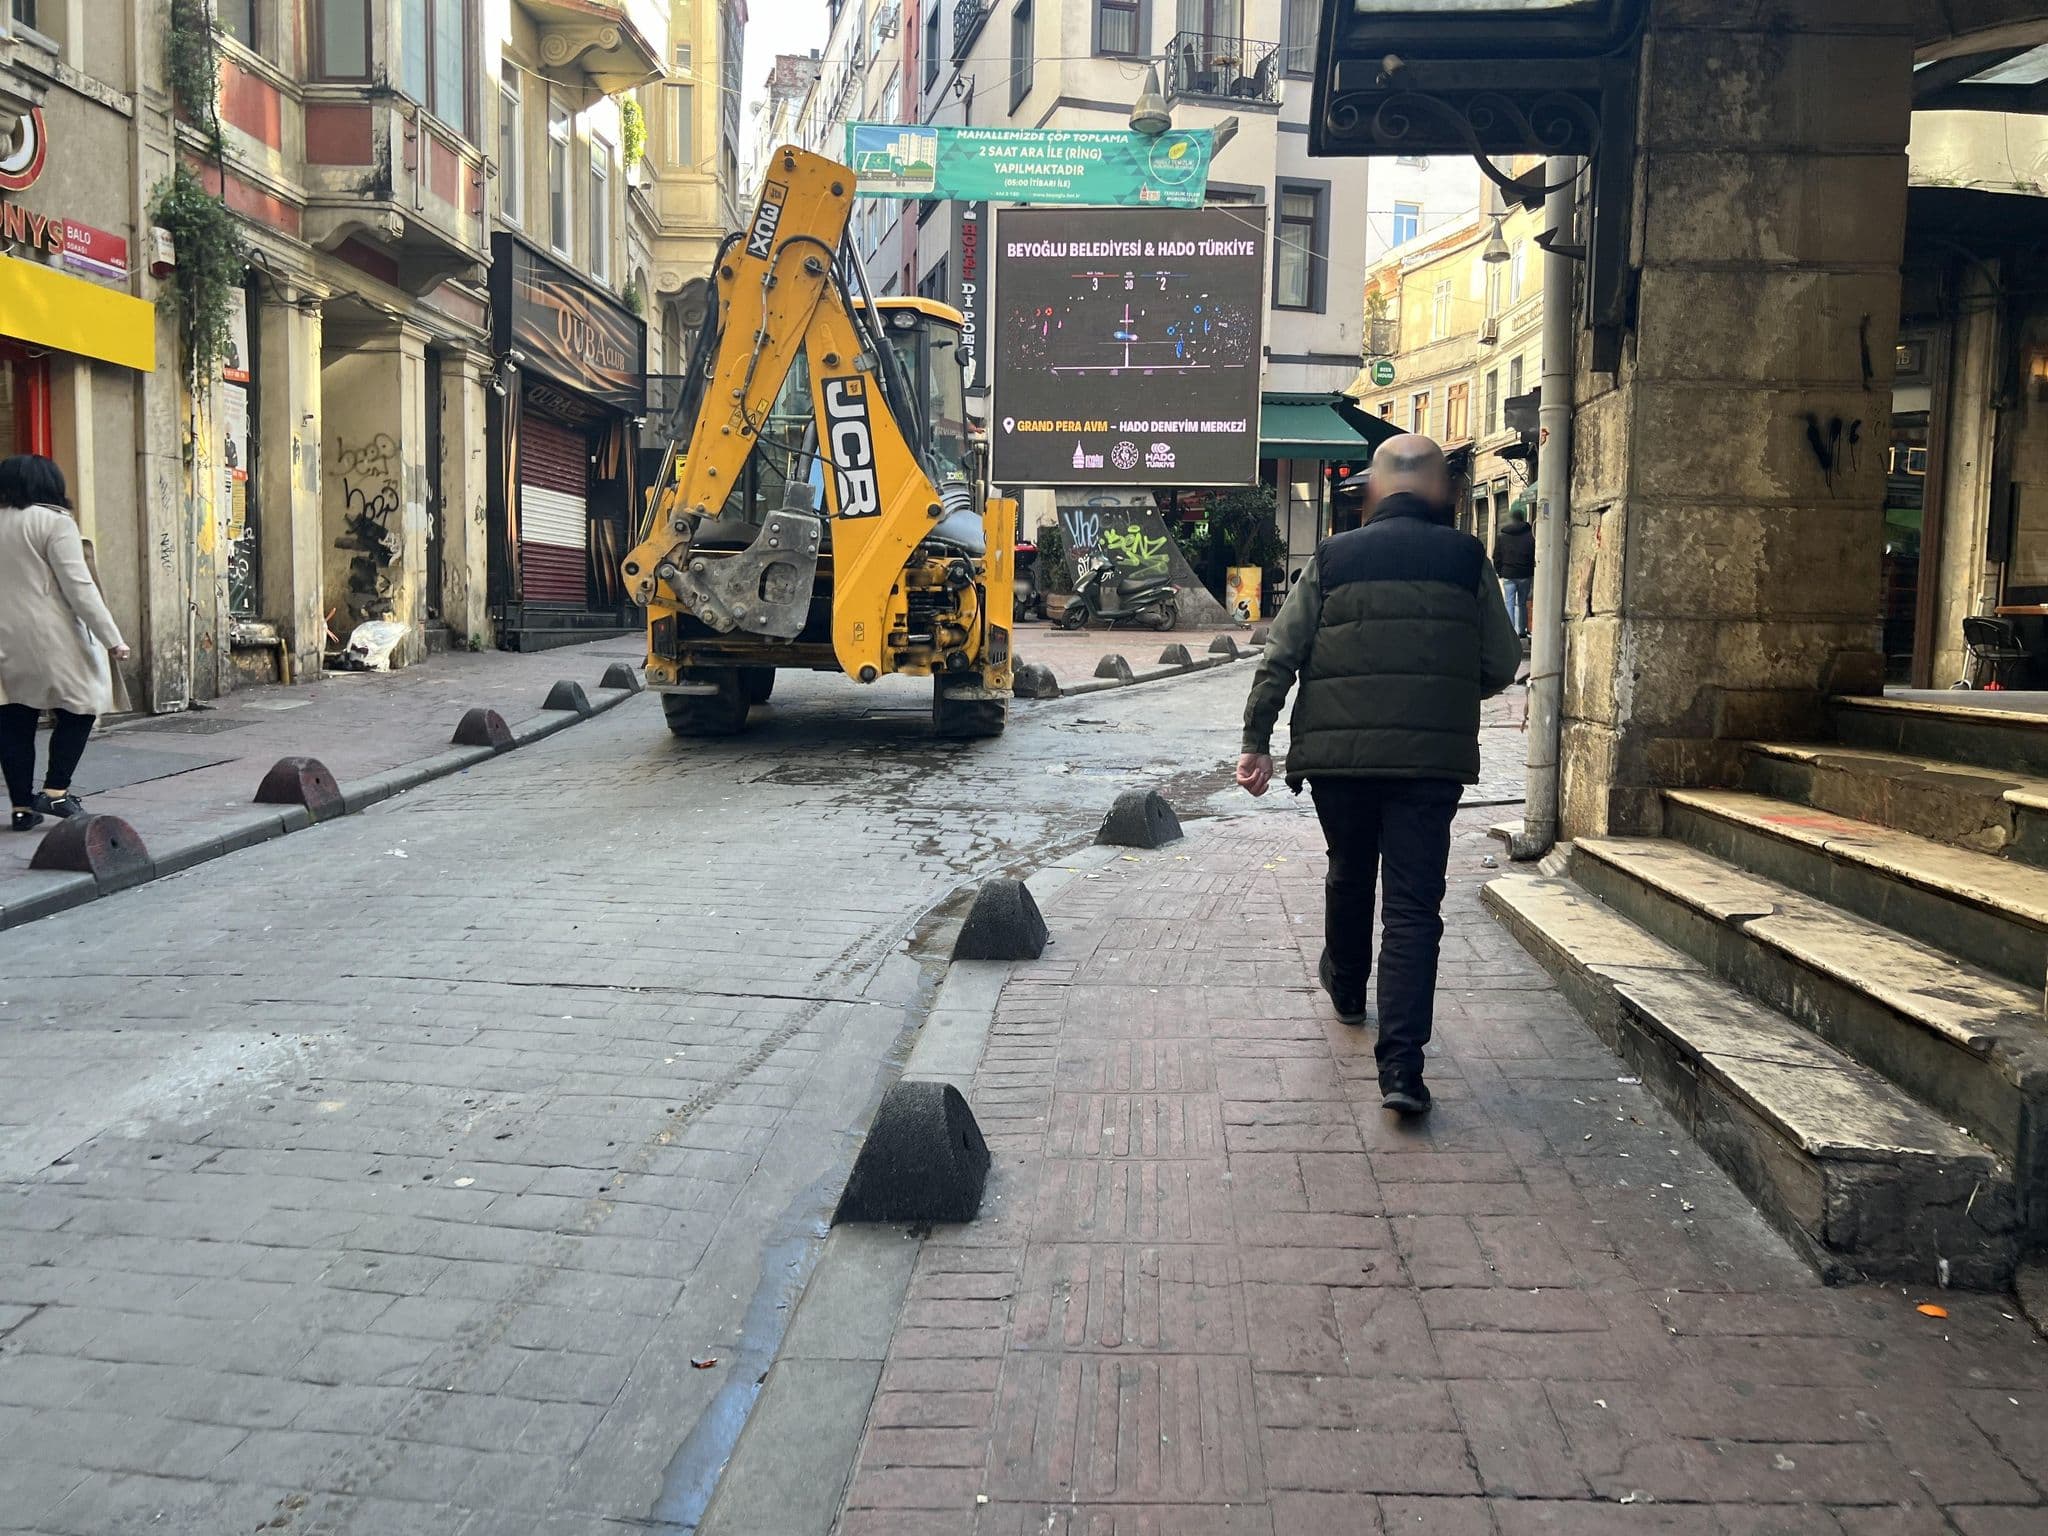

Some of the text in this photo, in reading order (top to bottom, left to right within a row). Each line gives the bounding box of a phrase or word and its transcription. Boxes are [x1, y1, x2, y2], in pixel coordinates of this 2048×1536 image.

[957, 128, 1129, 144] MAHALLEMİZDE ÇÖP TOPLAMA
[979, 144, 1102, 161] 2 SAAT ARA İLE (RİNG)
[994, 163, 1085, 176] YAPILMAKTADIR
[0, 199, 64, 255] NYS
[66, 225, 91, 246] BALO
[962, 223, 977, 281] HOTEL
[1007, 238, 1254, 258] BEYOĞLU BELEDİYESİ & HADO TÜRKİYE
[1092, 277, 1099, 291] 3
[1124, 279, 1134, 290] 30
[1160, 277, 1167, 291] 2
[558, 305, 607, 367] QUBA
[1017, 420, 1053, 433] GRAND
[1055, 420, 1081, 433] PERA
[1083, 420, 1108, 433] AVM
[1119, 420, 1149, 433] HADO
[1151, 418, 1199, 433] DENEYİM
[1200, 418, 1247, 433] MERKEZİ
[826, 381, 877, 516] JCB
[1145, 453, 1176, 461] HADO
